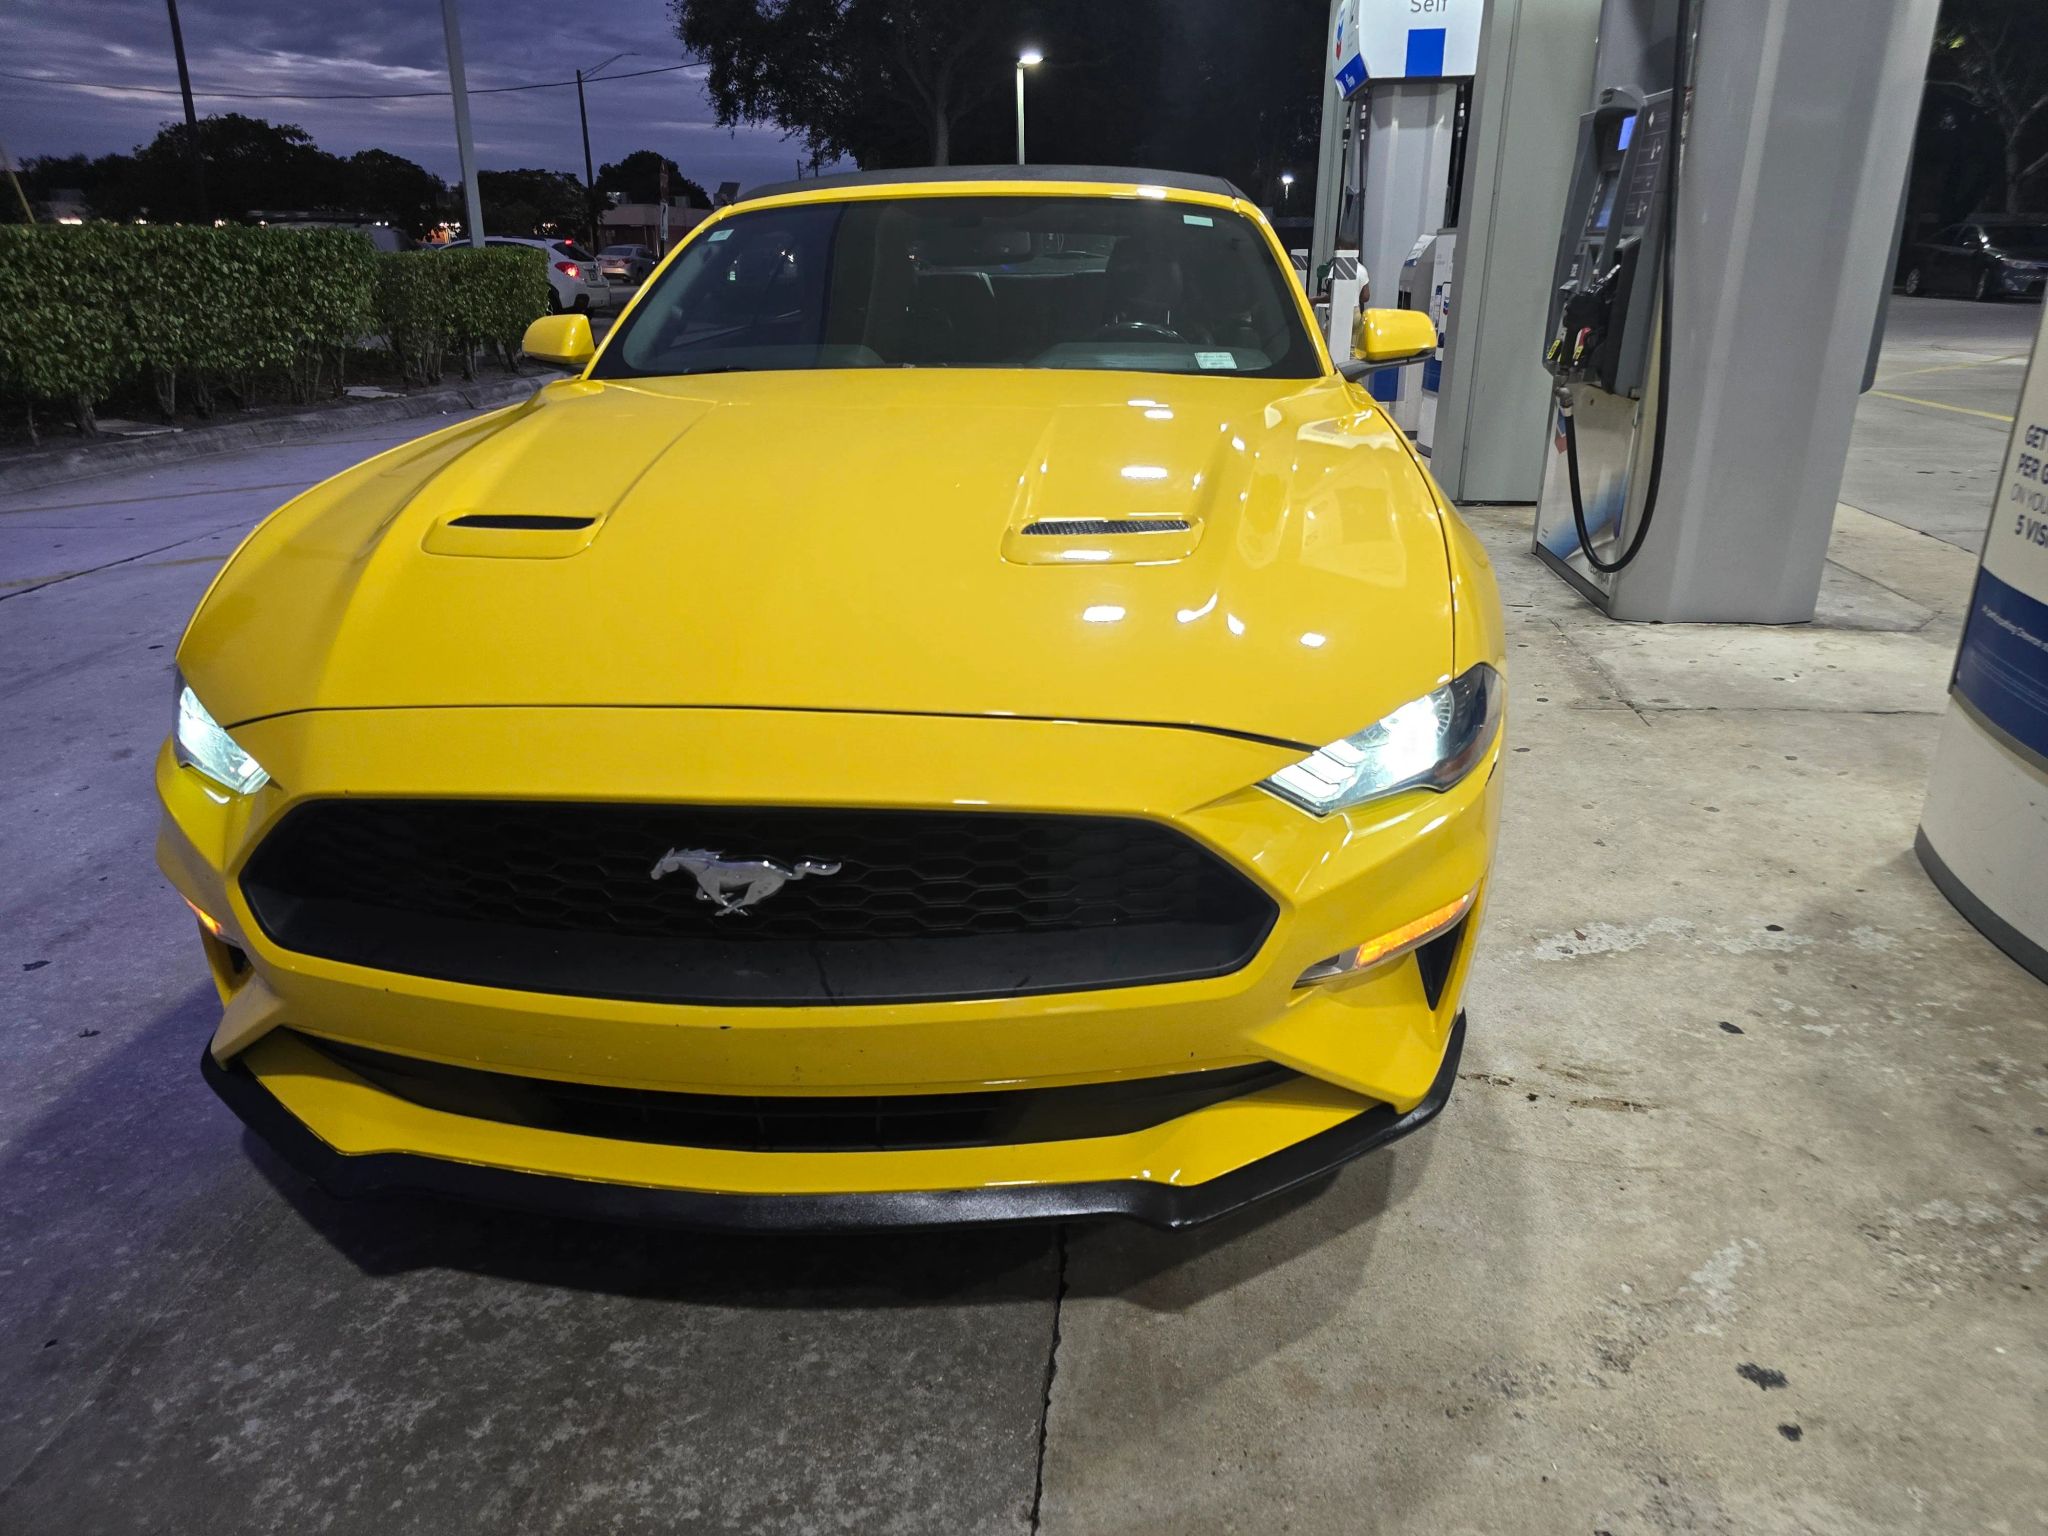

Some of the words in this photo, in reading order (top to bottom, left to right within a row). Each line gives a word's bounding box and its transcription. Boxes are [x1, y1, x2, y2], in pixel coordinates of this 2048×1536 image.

[1410, 0, 1447, 13] Self
[2025, 424, 2048, 451] GET
[2017, 453, 2041, 481] PER
[2015, 514, 2025, 535] 5
